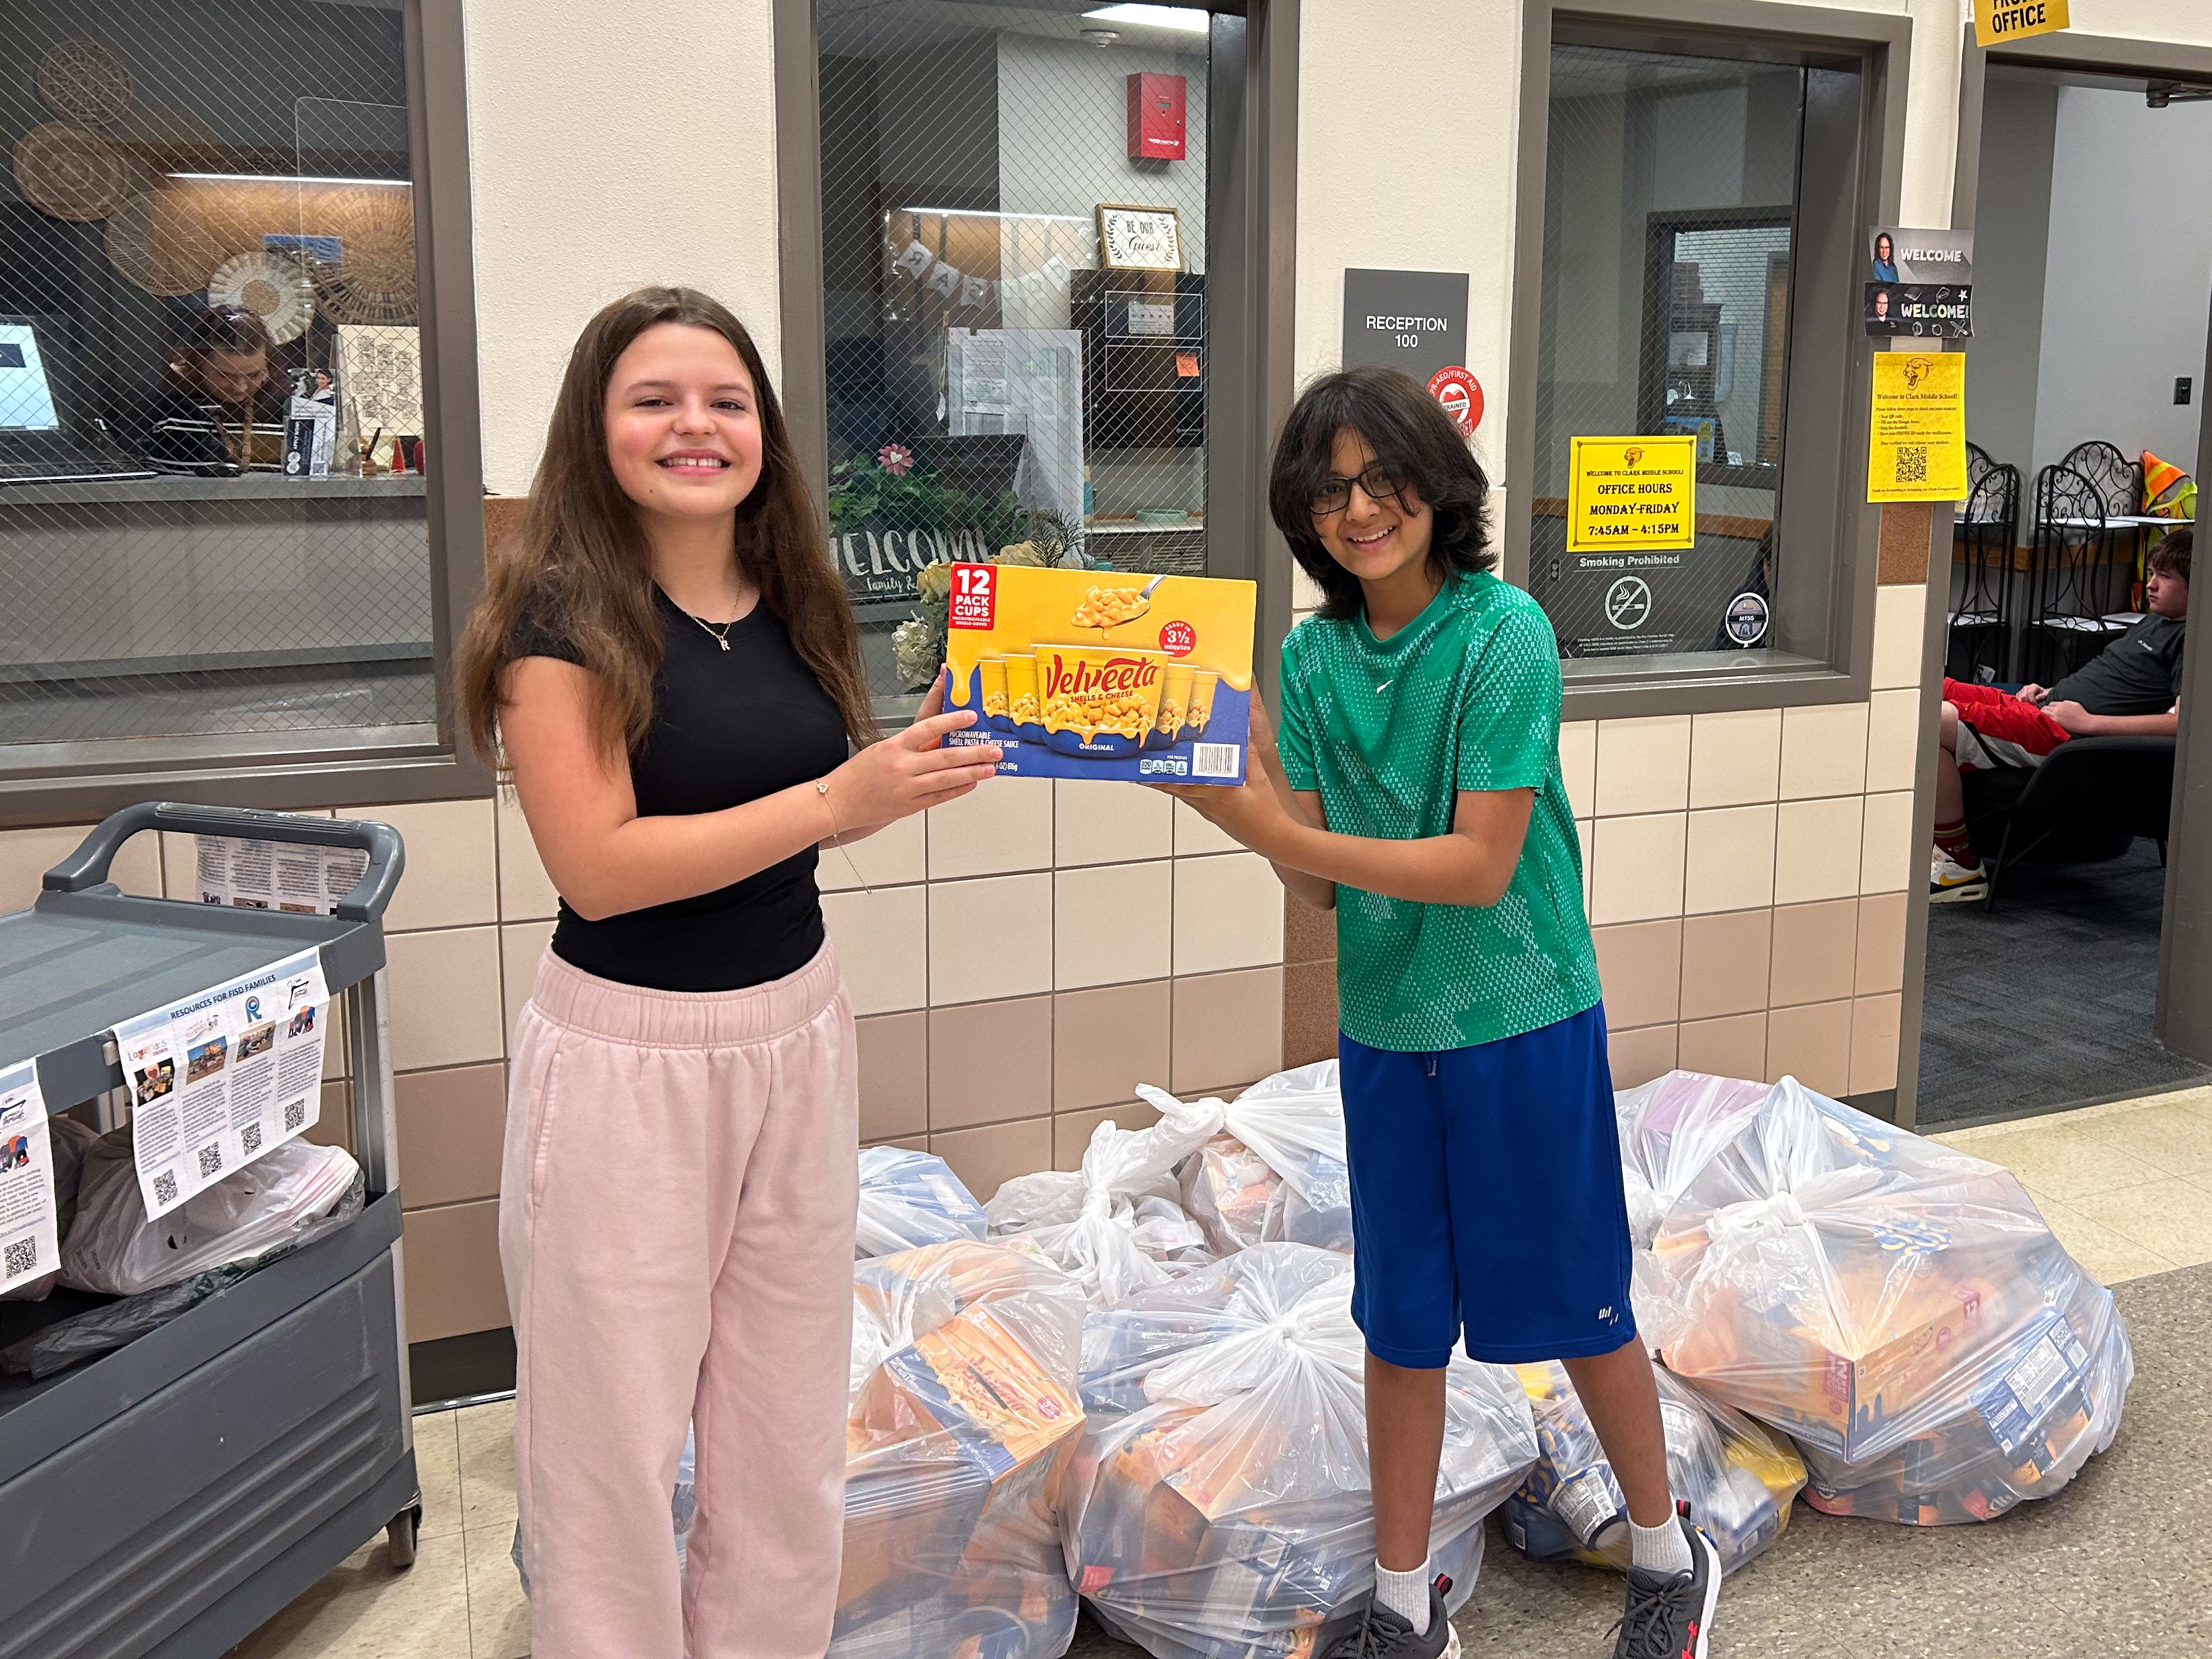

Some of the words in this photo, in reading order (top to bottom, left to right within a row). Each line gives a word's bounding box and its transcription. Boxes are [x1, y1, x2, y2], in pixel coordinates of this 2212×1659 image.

[1992, 3, 2046, 33] OFFICE
[1126, 221, 1136, 233] BE
[1140, 222, 1154, 234] OUR
[1901, 249, 1962, 262] WELCOME
[1901, 303, 1969, 319] WELCOME!
[1366, 316, 1447, 332] RECEPTION
[1395, 334, 1418, 348] 100
[1467, 379, 1477, 392] AID
[1598, 484, 1635, 494] OFFICE
[1638, 484, 1672, 494] HOURS
[1589, 501, 1680, 515] MONDAY-FRIDAY
[1588, 525, 1629, 536] 7:45AM
[1641, 523, 1679, 534] 4:15PM
[829, 528, 989, 577] ELCOM
[1580, 557, 1625, 567] Smoking
[1627, 555, 1680, 566] Prohibited
[957, 568, 990, 595] 12
[955, 595, 990, 606] PACK
[955, 605, 989, 617] CUPS
[1165, 622, 1184, 631] READY
[1046, 654, 1160, 698] Velveeta
[1105, 690, 1134, 700] CHEESE
[1079, 743, 1115, 751] ORIGINAL
[170, 999, 212, 1020] RESOURCES
[213, 992, 227, 1004] FOR
[228, 987, 244, 998] FISD
[245, 974, 276, 992] FAMILIES
[973, 1311, 988, 1325] 8
[982, 1321, 1000, 1337] PACK
